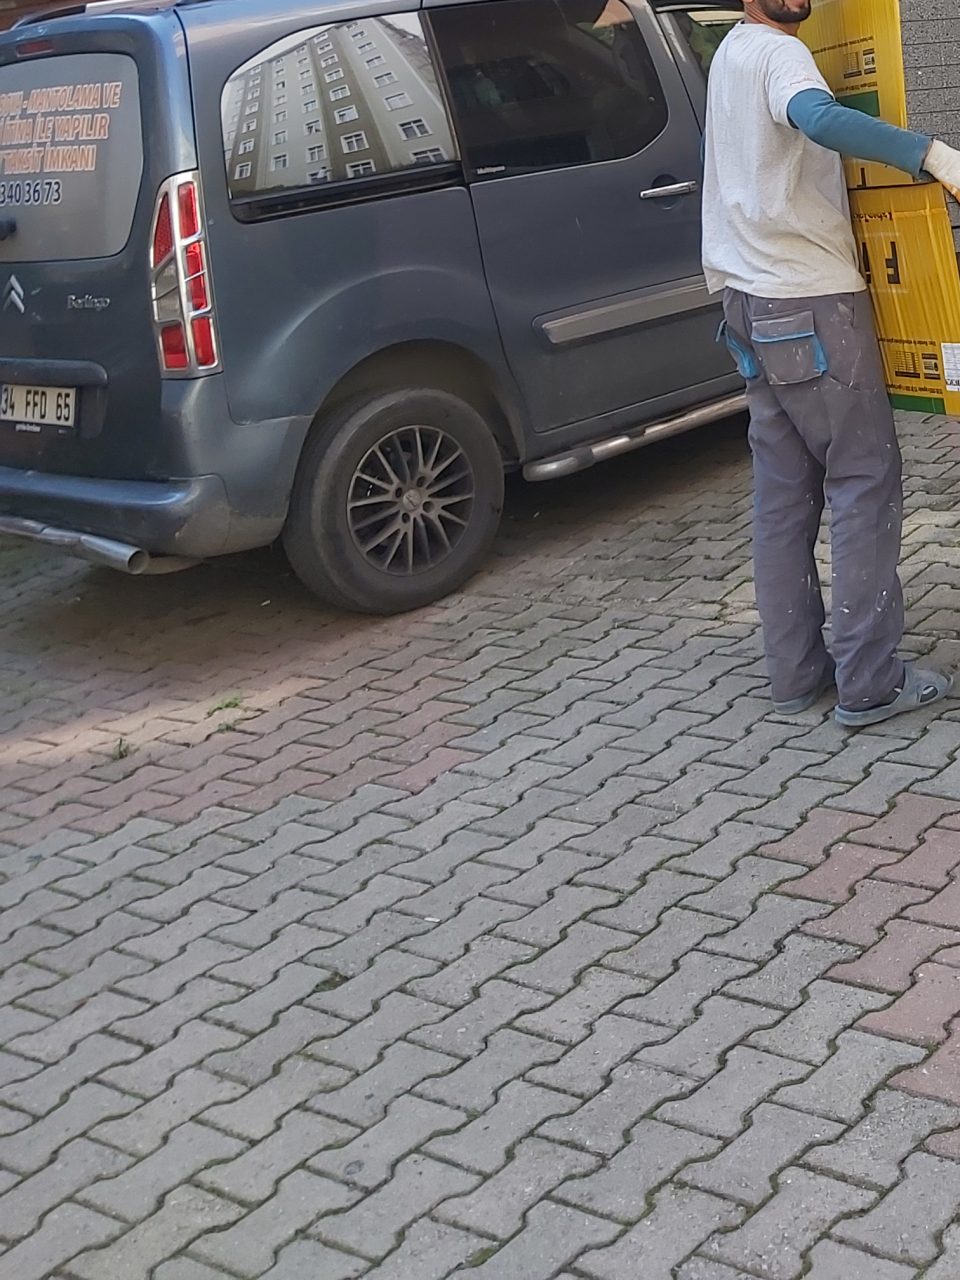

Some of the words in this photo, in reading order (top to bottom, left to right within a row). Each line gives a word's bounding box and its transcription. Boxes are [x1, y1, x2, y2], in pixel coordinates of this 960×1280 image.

[102, 81, 122, 108] VE
[33, 113, 54, 143] İLE
[55, 113, 110, 141] YAPILIR
[43, 142, 97, 172] İMKANI
[67, 294, 111, 312] Berlingo
[1, 387, 15, 417] 34
[24, 389, 47, 420] FFD
[55, 391, 71, 422] 65
